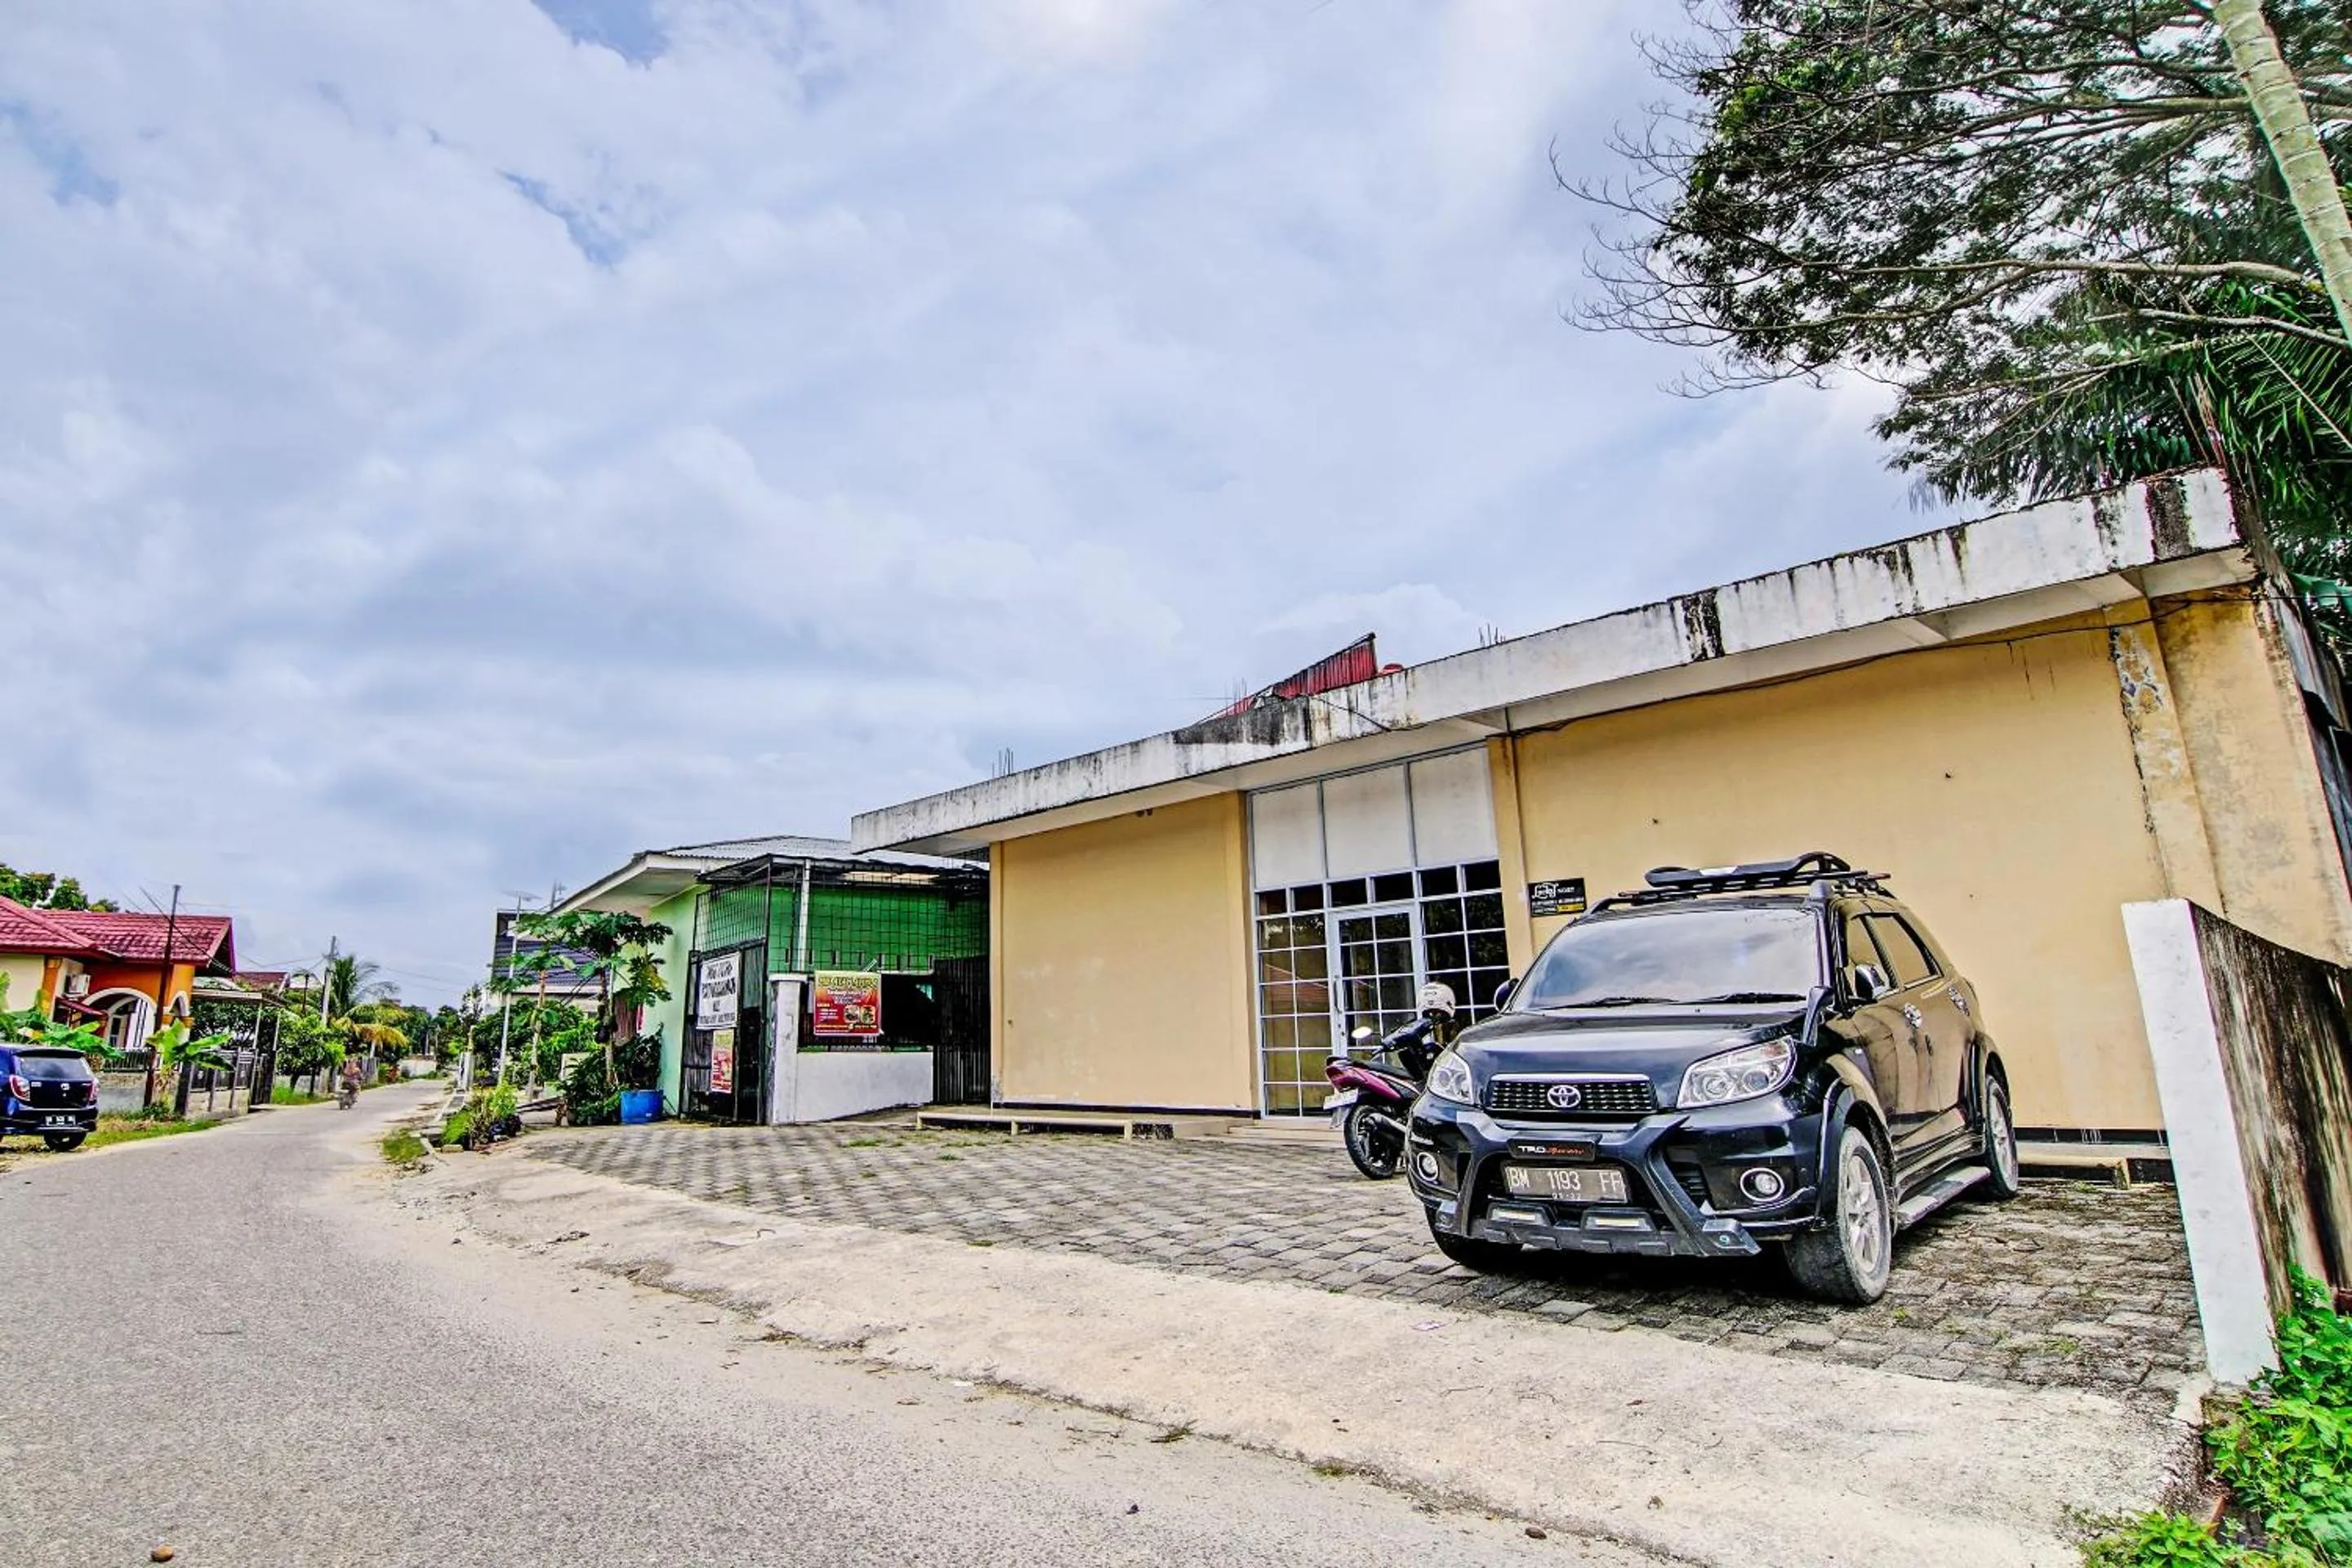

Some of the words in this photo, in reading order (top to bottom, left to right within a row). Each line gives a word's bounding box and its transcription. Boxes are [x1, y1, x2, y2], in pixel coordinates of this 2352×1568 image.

[1517, 1145, 1546, 1154] TRD
[1510, 1167, 1530, 1188] BM
[1547, 1170, 1582, 1192] 1193
